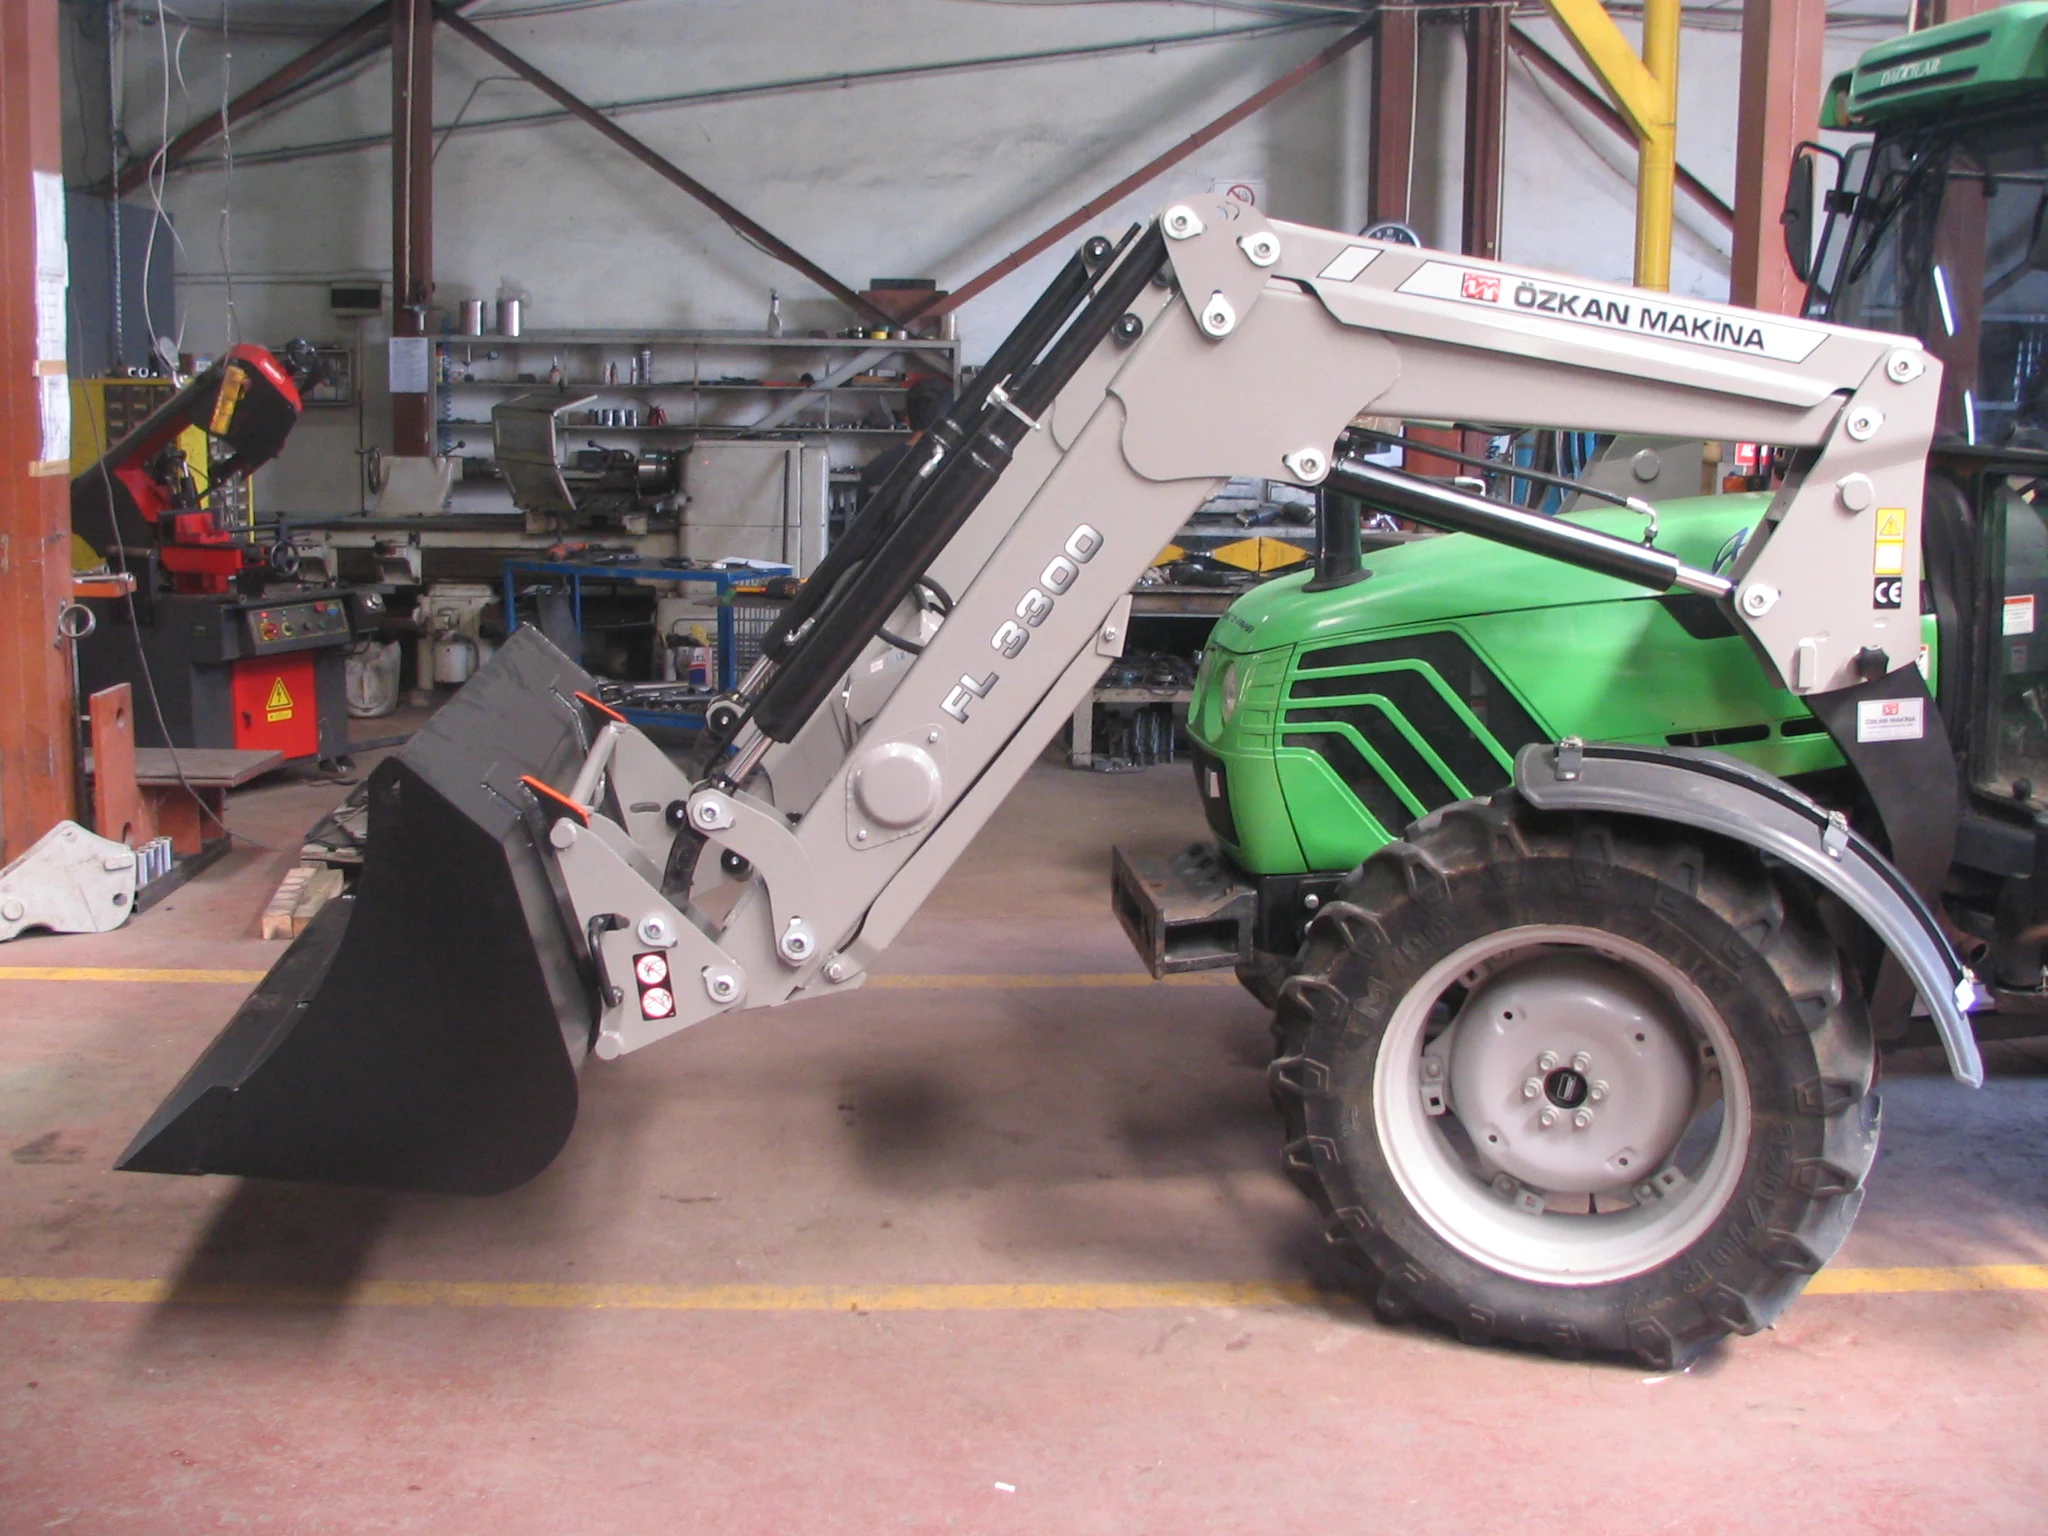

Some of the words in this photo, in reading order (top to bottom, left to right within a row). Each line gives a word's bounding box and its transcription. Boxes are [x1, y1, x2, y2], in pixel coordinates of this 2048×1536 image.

[1514, 281, 1627, 325] ÖZKAN
[1640, 307, 1764, 350] MAKİNA
[940, 671, 1000, 724] FL
[990, 523, 1104, 660] 3300
[1874, 581, 1902, 604] CE
